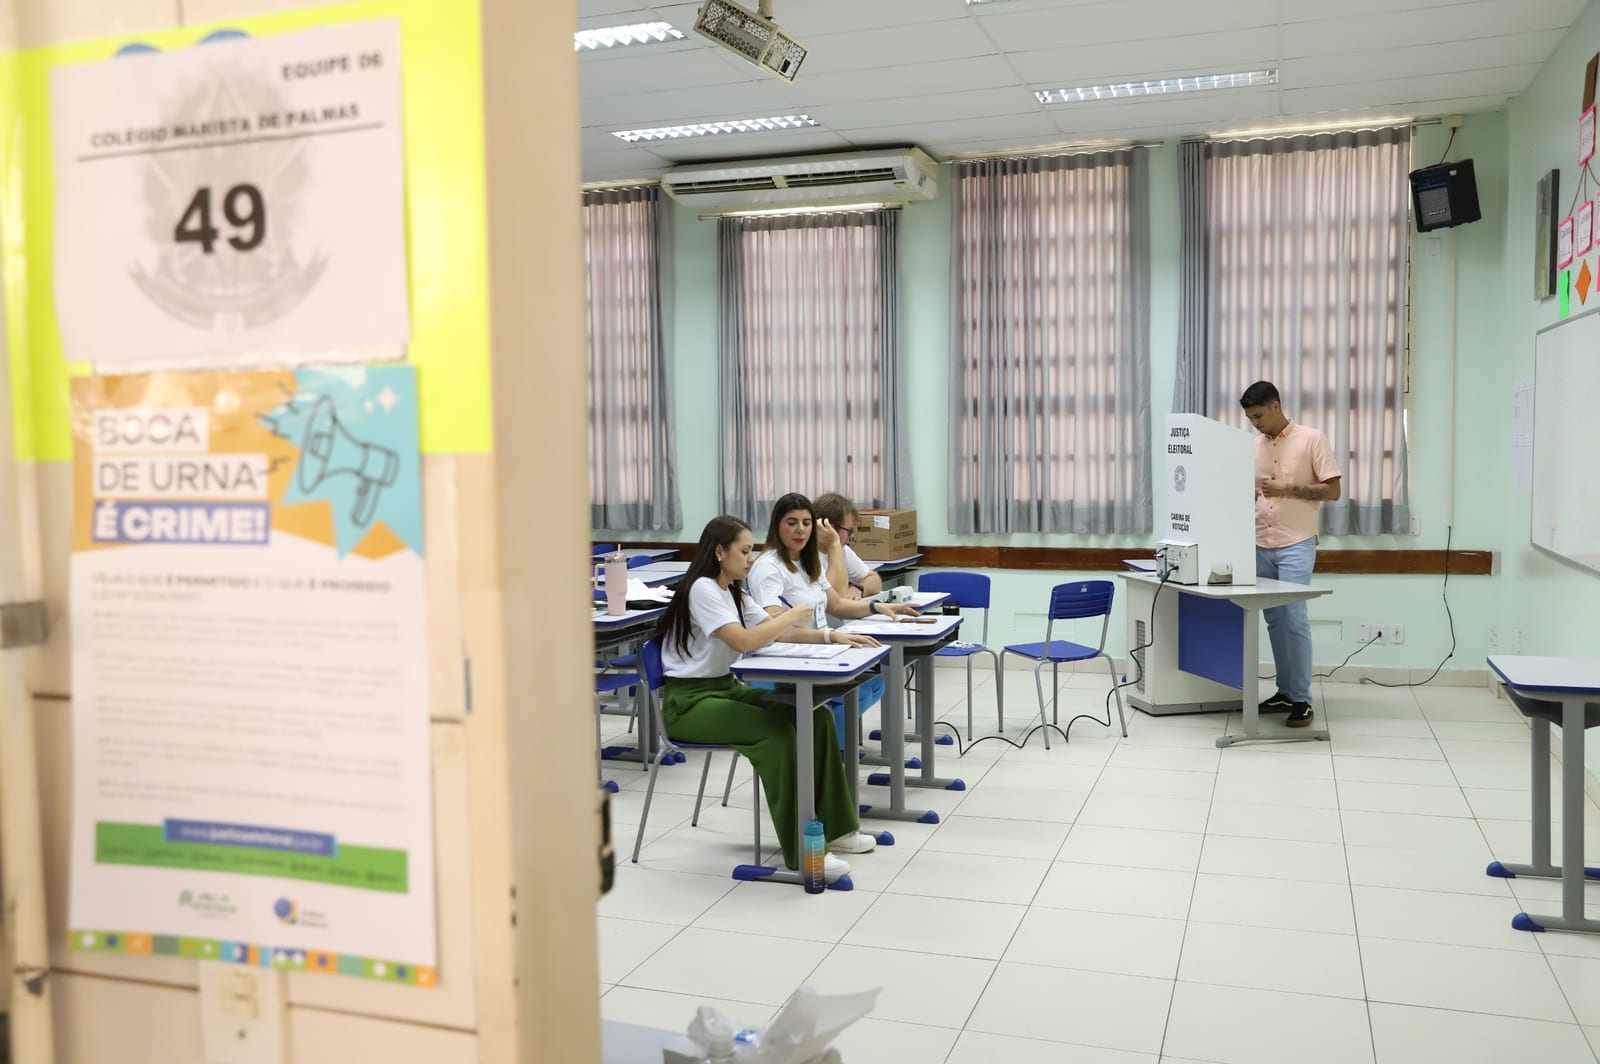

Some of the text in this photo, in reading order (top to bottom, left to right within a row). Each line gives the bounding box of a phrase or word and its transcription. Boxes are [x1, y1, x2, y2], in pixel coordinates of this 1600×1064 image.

[281, 55, 351, 82] EQUIPE
[172, 116, 251, 140] MARISTA
[258, 113, 281, 131] DE
[285, 103, 361, 127] PALMAS
[174, 182, 268, 256] 49
[99, 413, 201, 446] BOCA
[1170, 427, 1190, 439] JUSTIÇA
[1168, 444, 1193, 455] ELEITORAL
[99, 461, 258, 492] DE URNA
[96, 500, 267, 543] É CRIME!
